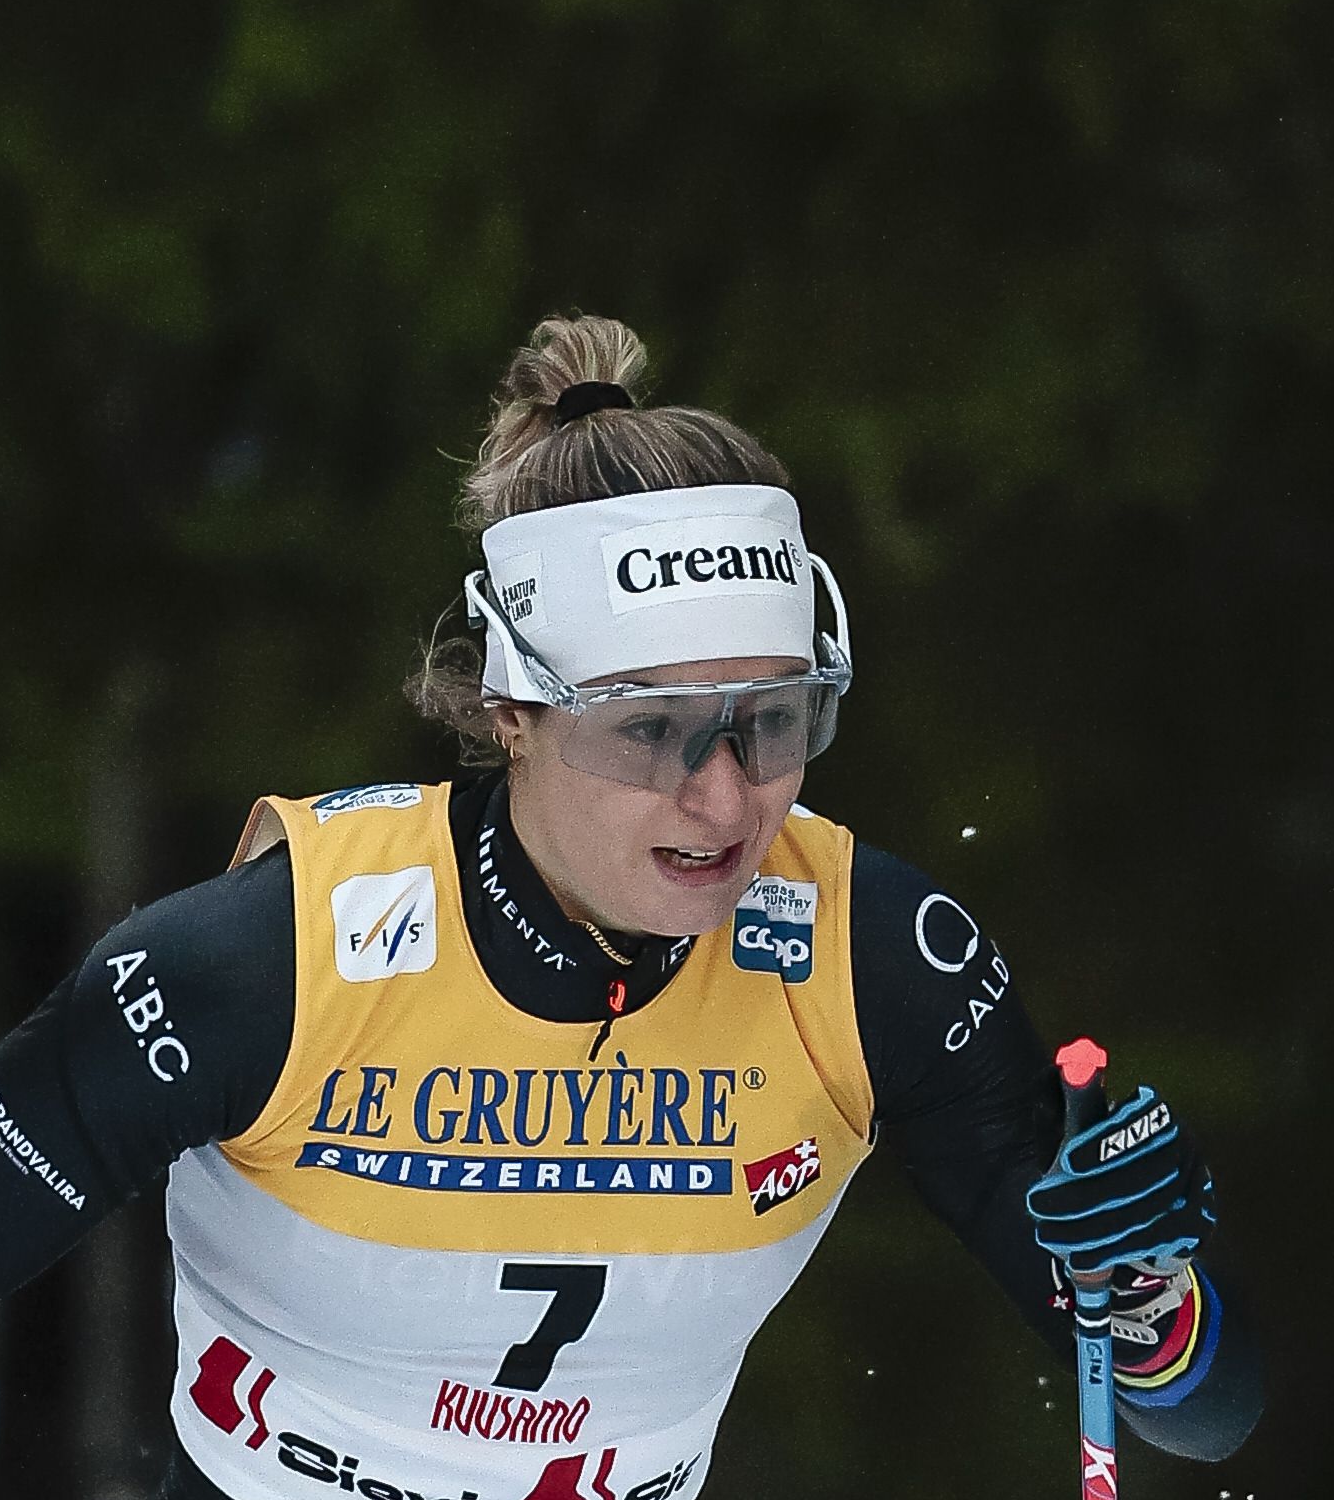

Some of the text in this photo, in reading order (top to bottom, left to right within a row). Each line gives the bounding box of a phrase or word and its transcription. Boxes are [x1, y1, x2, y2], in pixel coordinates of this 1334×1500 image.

[308, 1065, 398, 1139] LE
[316, 1148, 716, 1190] SWITZERLAND
[491, 1262, 610, 1392] 7
[430, 1378, 592, 1444] KUUSAMO
